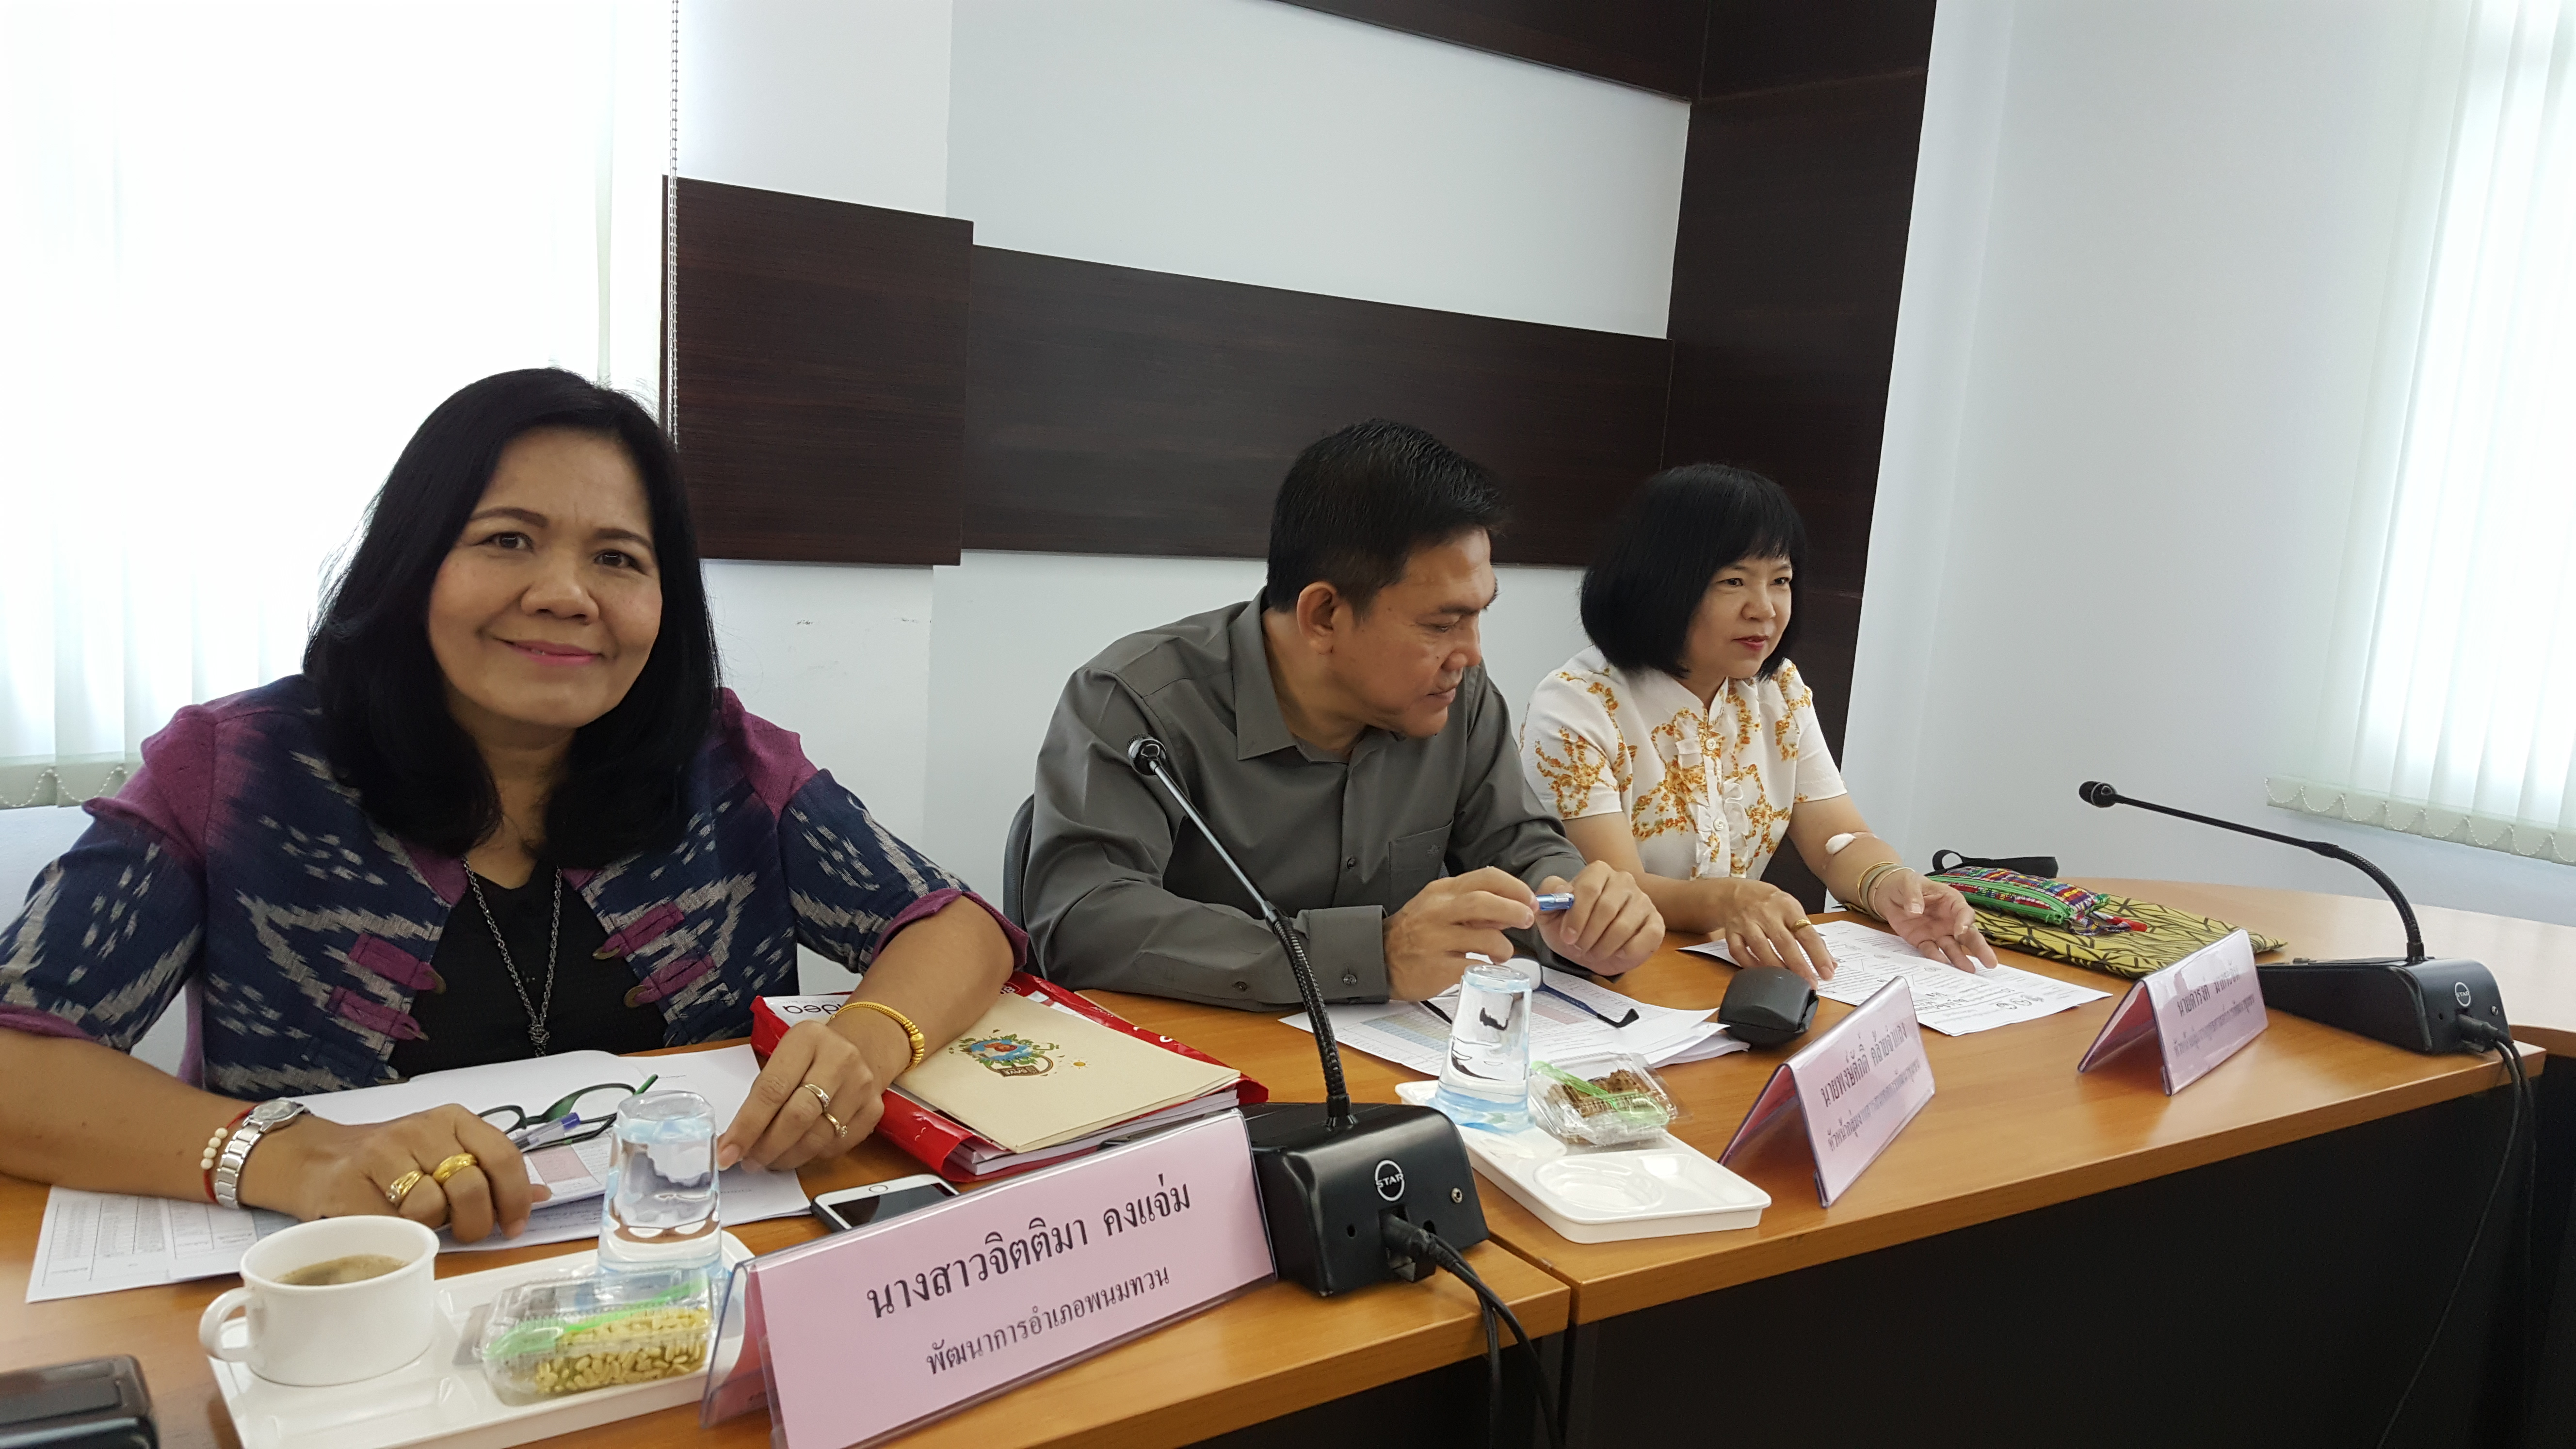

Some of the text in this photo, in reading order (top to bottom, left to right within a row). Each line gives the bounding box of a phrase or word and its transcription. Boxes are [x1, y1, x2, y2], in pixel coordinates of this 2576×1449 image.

[1376, 1173, 1403, 1188] STAR
[867, 1174, 1191, 1319] นางสาวจิตติมา คงแจ่ม
[926, 1266, 1170, 1375] พัฒนาการอำเภอพนมทวน
